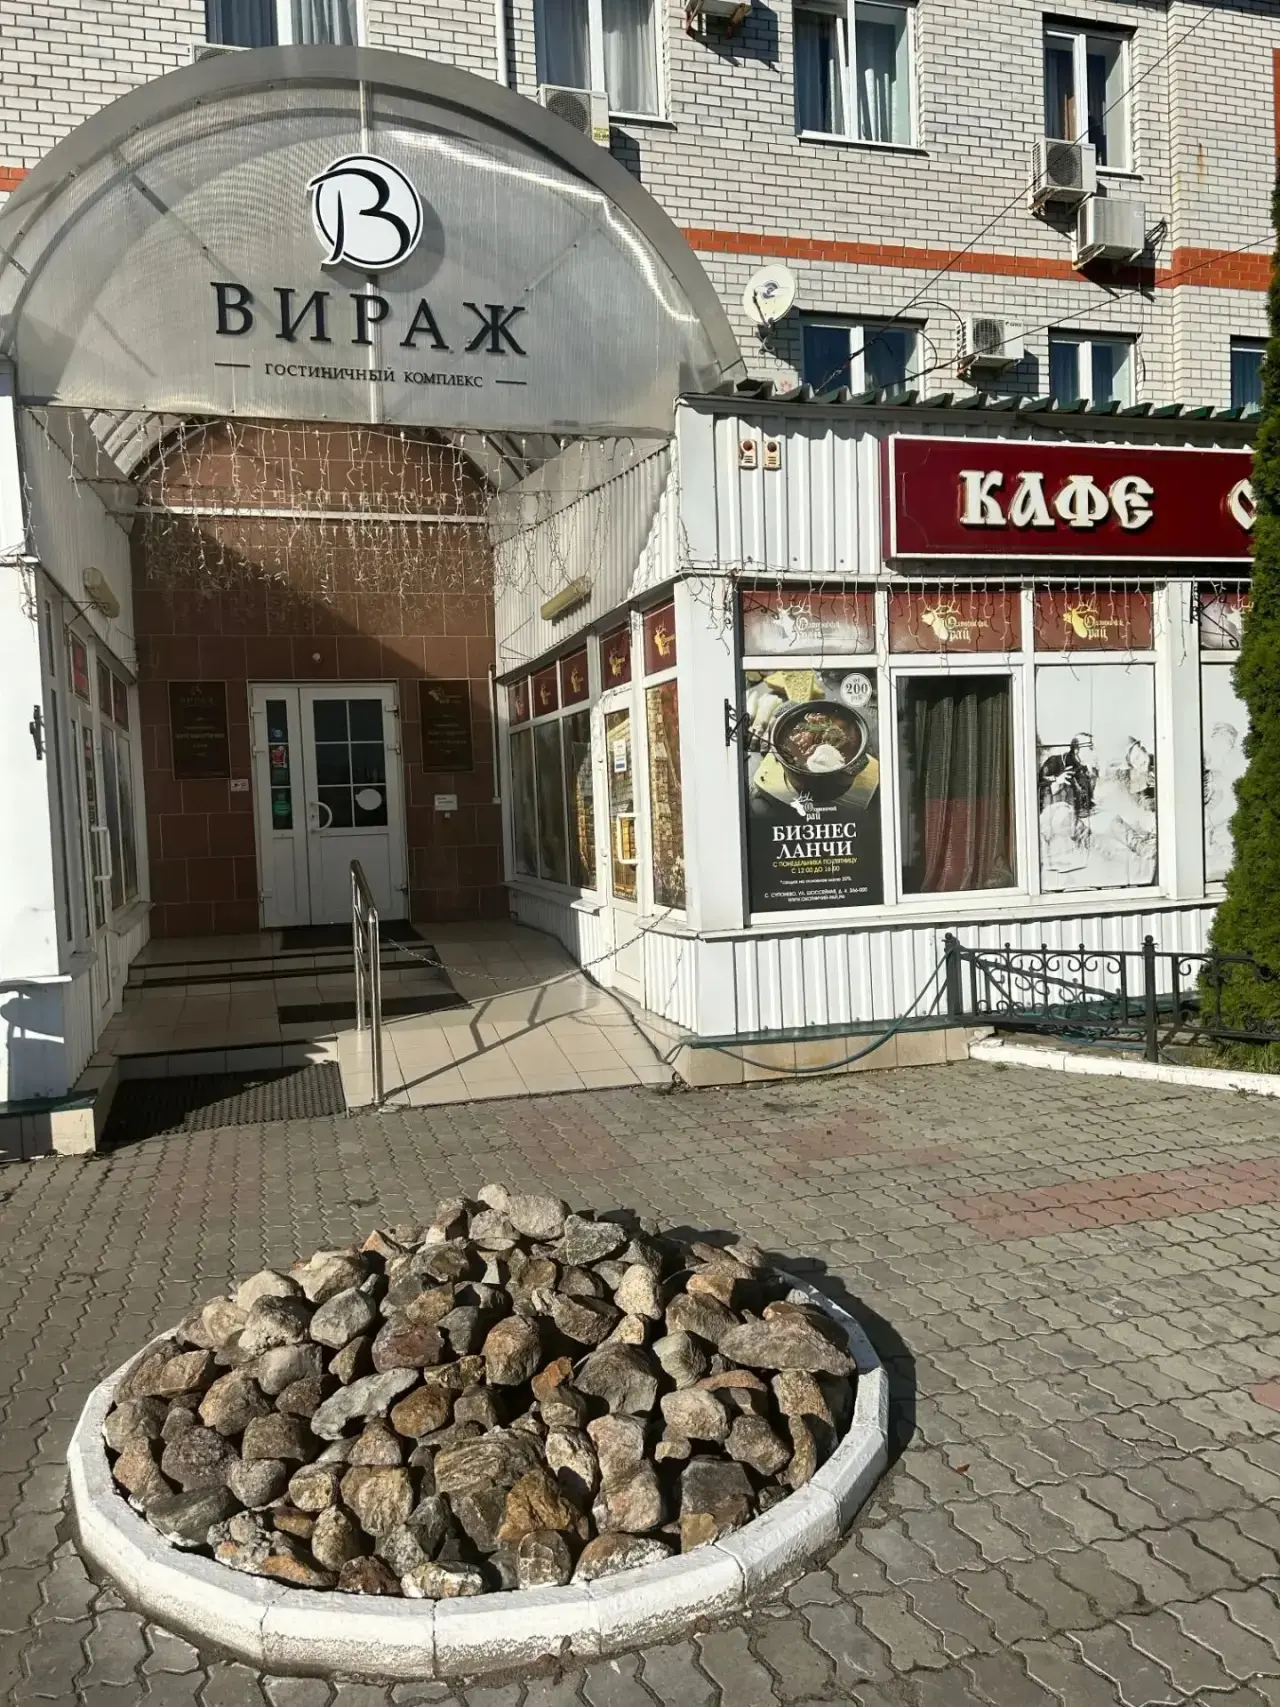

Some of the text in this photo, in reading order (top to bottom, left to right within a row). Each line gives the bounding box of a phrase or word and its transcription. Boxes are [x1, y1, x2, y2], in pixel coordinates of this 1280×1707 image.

[210, 281, 528, 356] ВИРАЖ
[264, 362, 484, 388] ГОСТИНИЧНЫЙ КОМПЛЕКС
[959, 470, 1154, 530] КАФЕ
[846, 683, 868, 694] 200
[772, 822, 857, 841] БИЗНЕС
[776, 841, 853, 859] ЛАНЧИ
